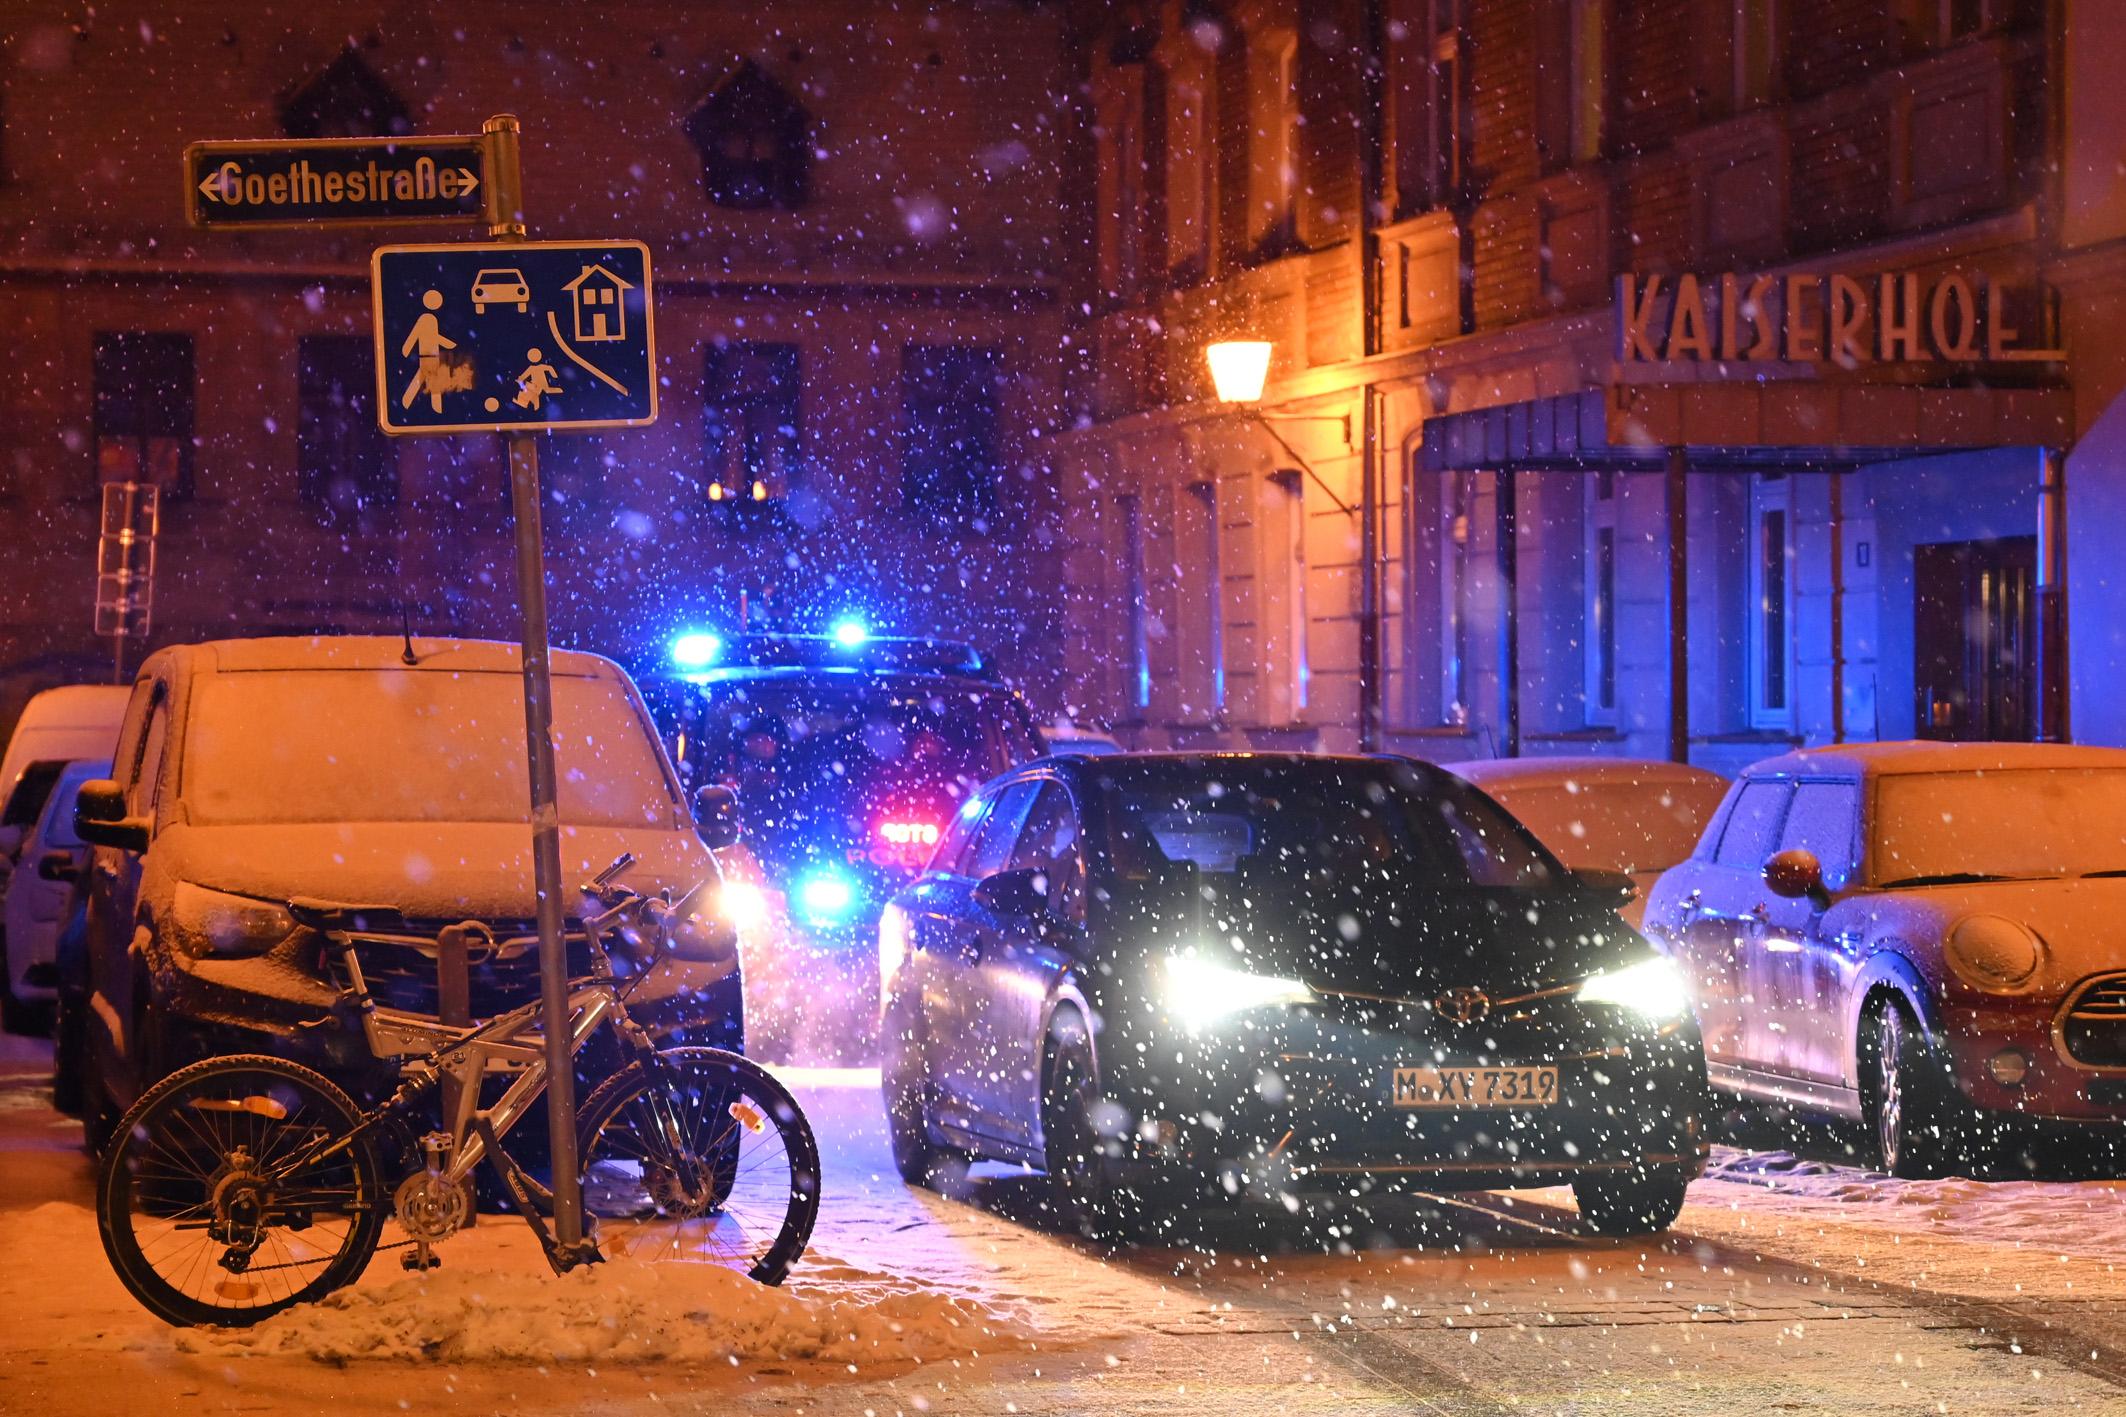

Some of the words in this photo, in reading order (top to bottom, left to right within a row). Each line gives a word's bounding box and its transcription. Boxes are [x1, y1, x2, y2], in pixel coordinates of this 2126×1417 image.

[220, 157, 458, 205] Goethestraße
[1620, 271, 2026, 361] KAISERHOF
[1397, 1072, 1416, 1101] M
[1438, 1071, 1475, 1101] XY
[1483, 1071, 1555, 1100] 7319
